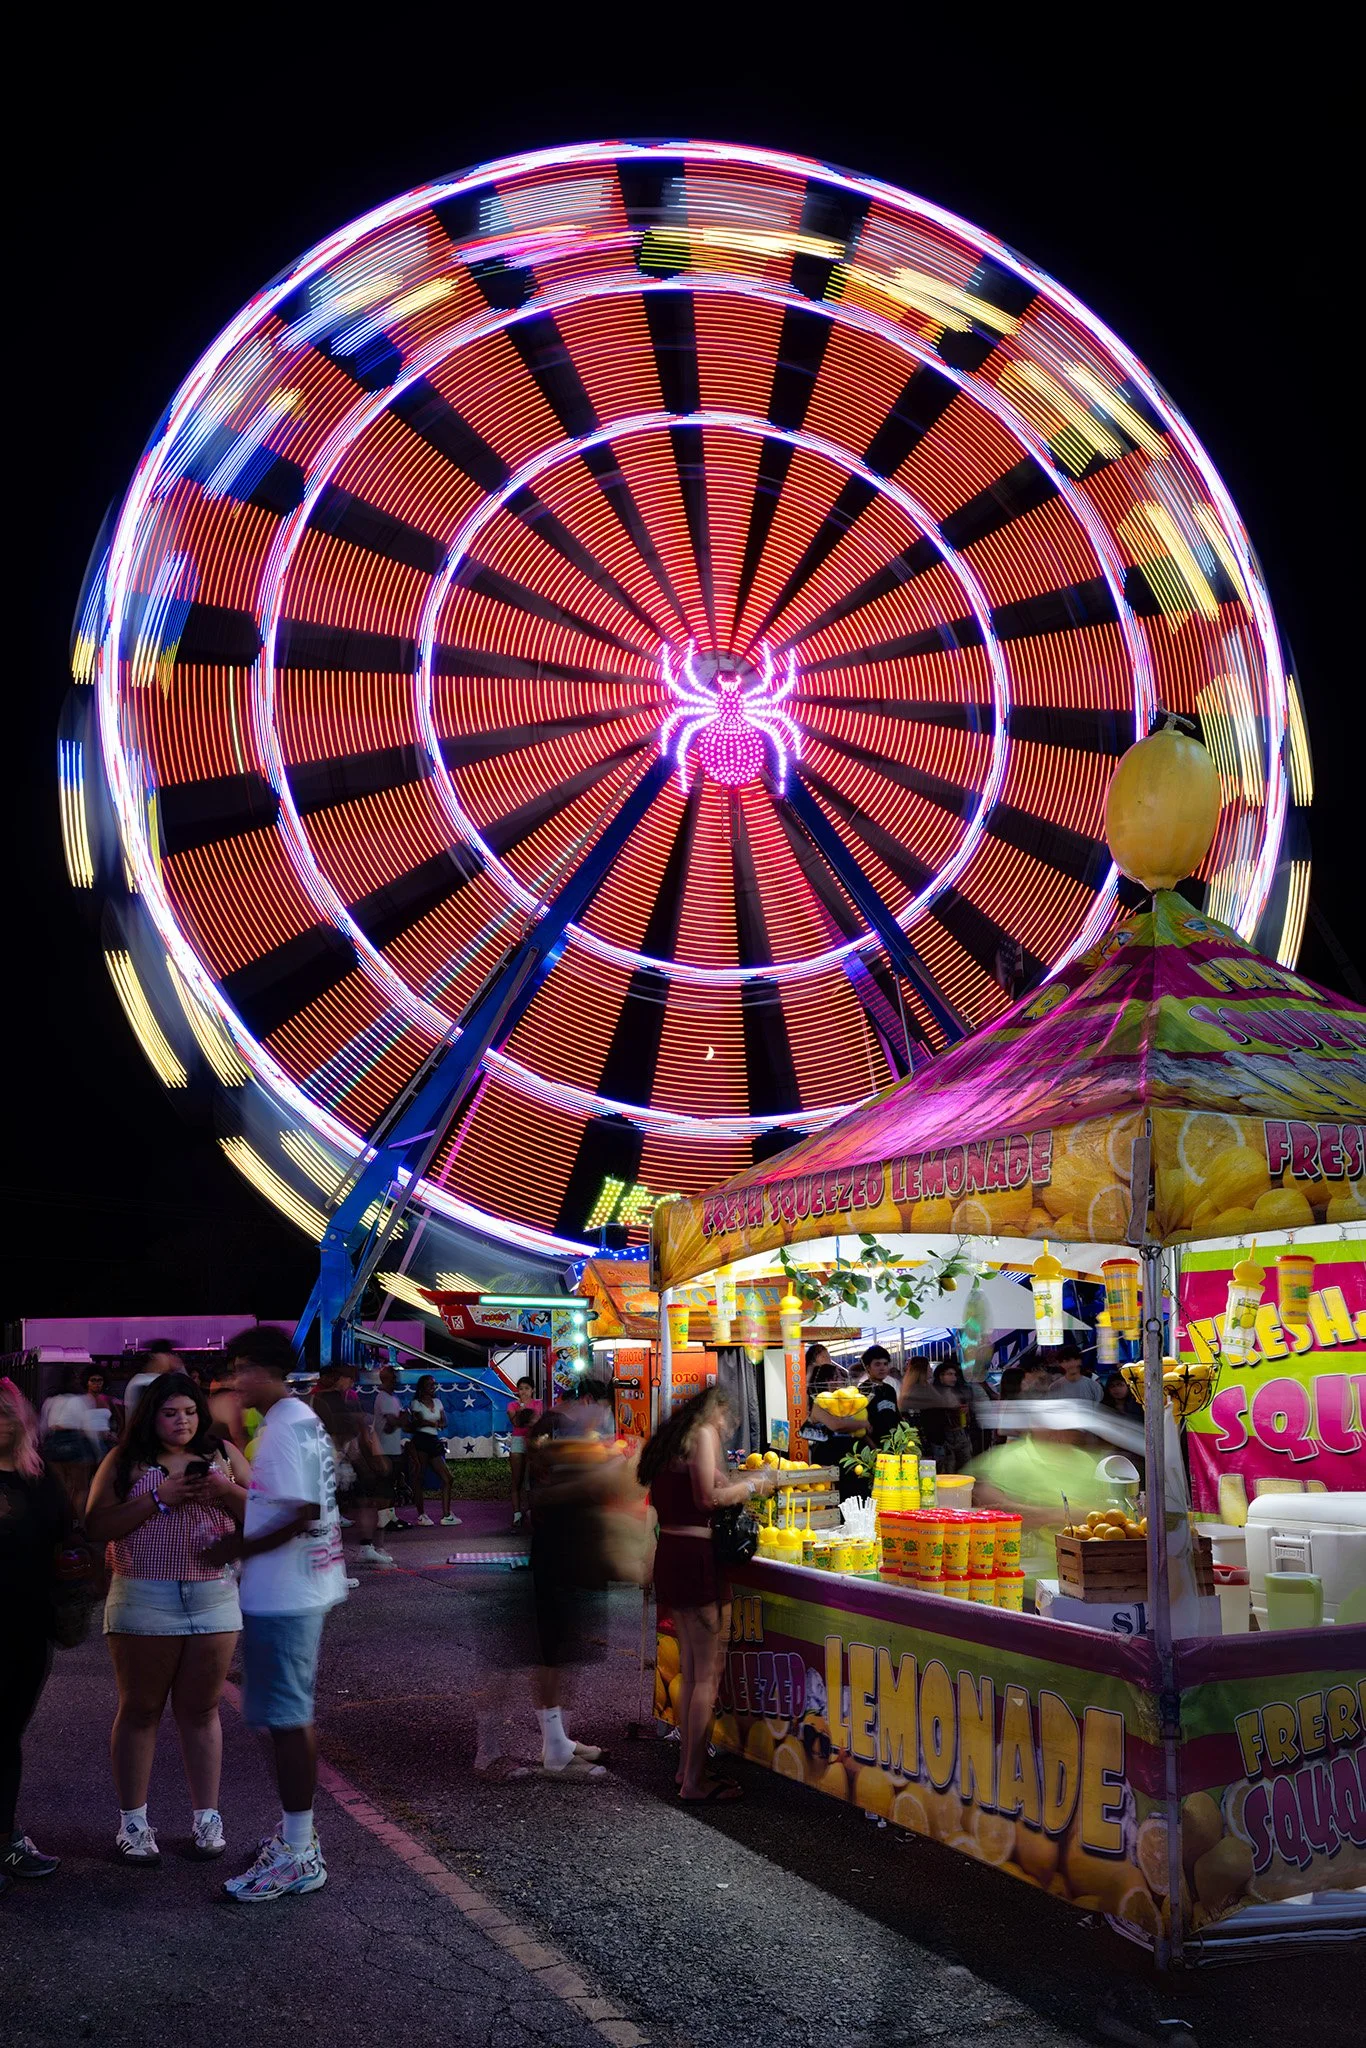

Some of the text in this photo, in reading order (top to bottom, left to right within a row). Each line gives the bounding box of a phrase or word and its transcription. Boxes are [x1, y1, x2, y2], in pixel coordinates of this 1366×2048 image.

[1264, 1119, 1366, 1179] FRES
[701, 1129, 1054, 1237] FRESH SQUEEZED LEMONADE
[671, 1287, 781, 1306] BOTH
[618, 1351, 643, 1363] PHOTO
[618, 1365, 644, 1378] BOOTH
[671, 1373, 699, 1383] OTO
[824, 1635, 1126, 1855] LEMONADE
